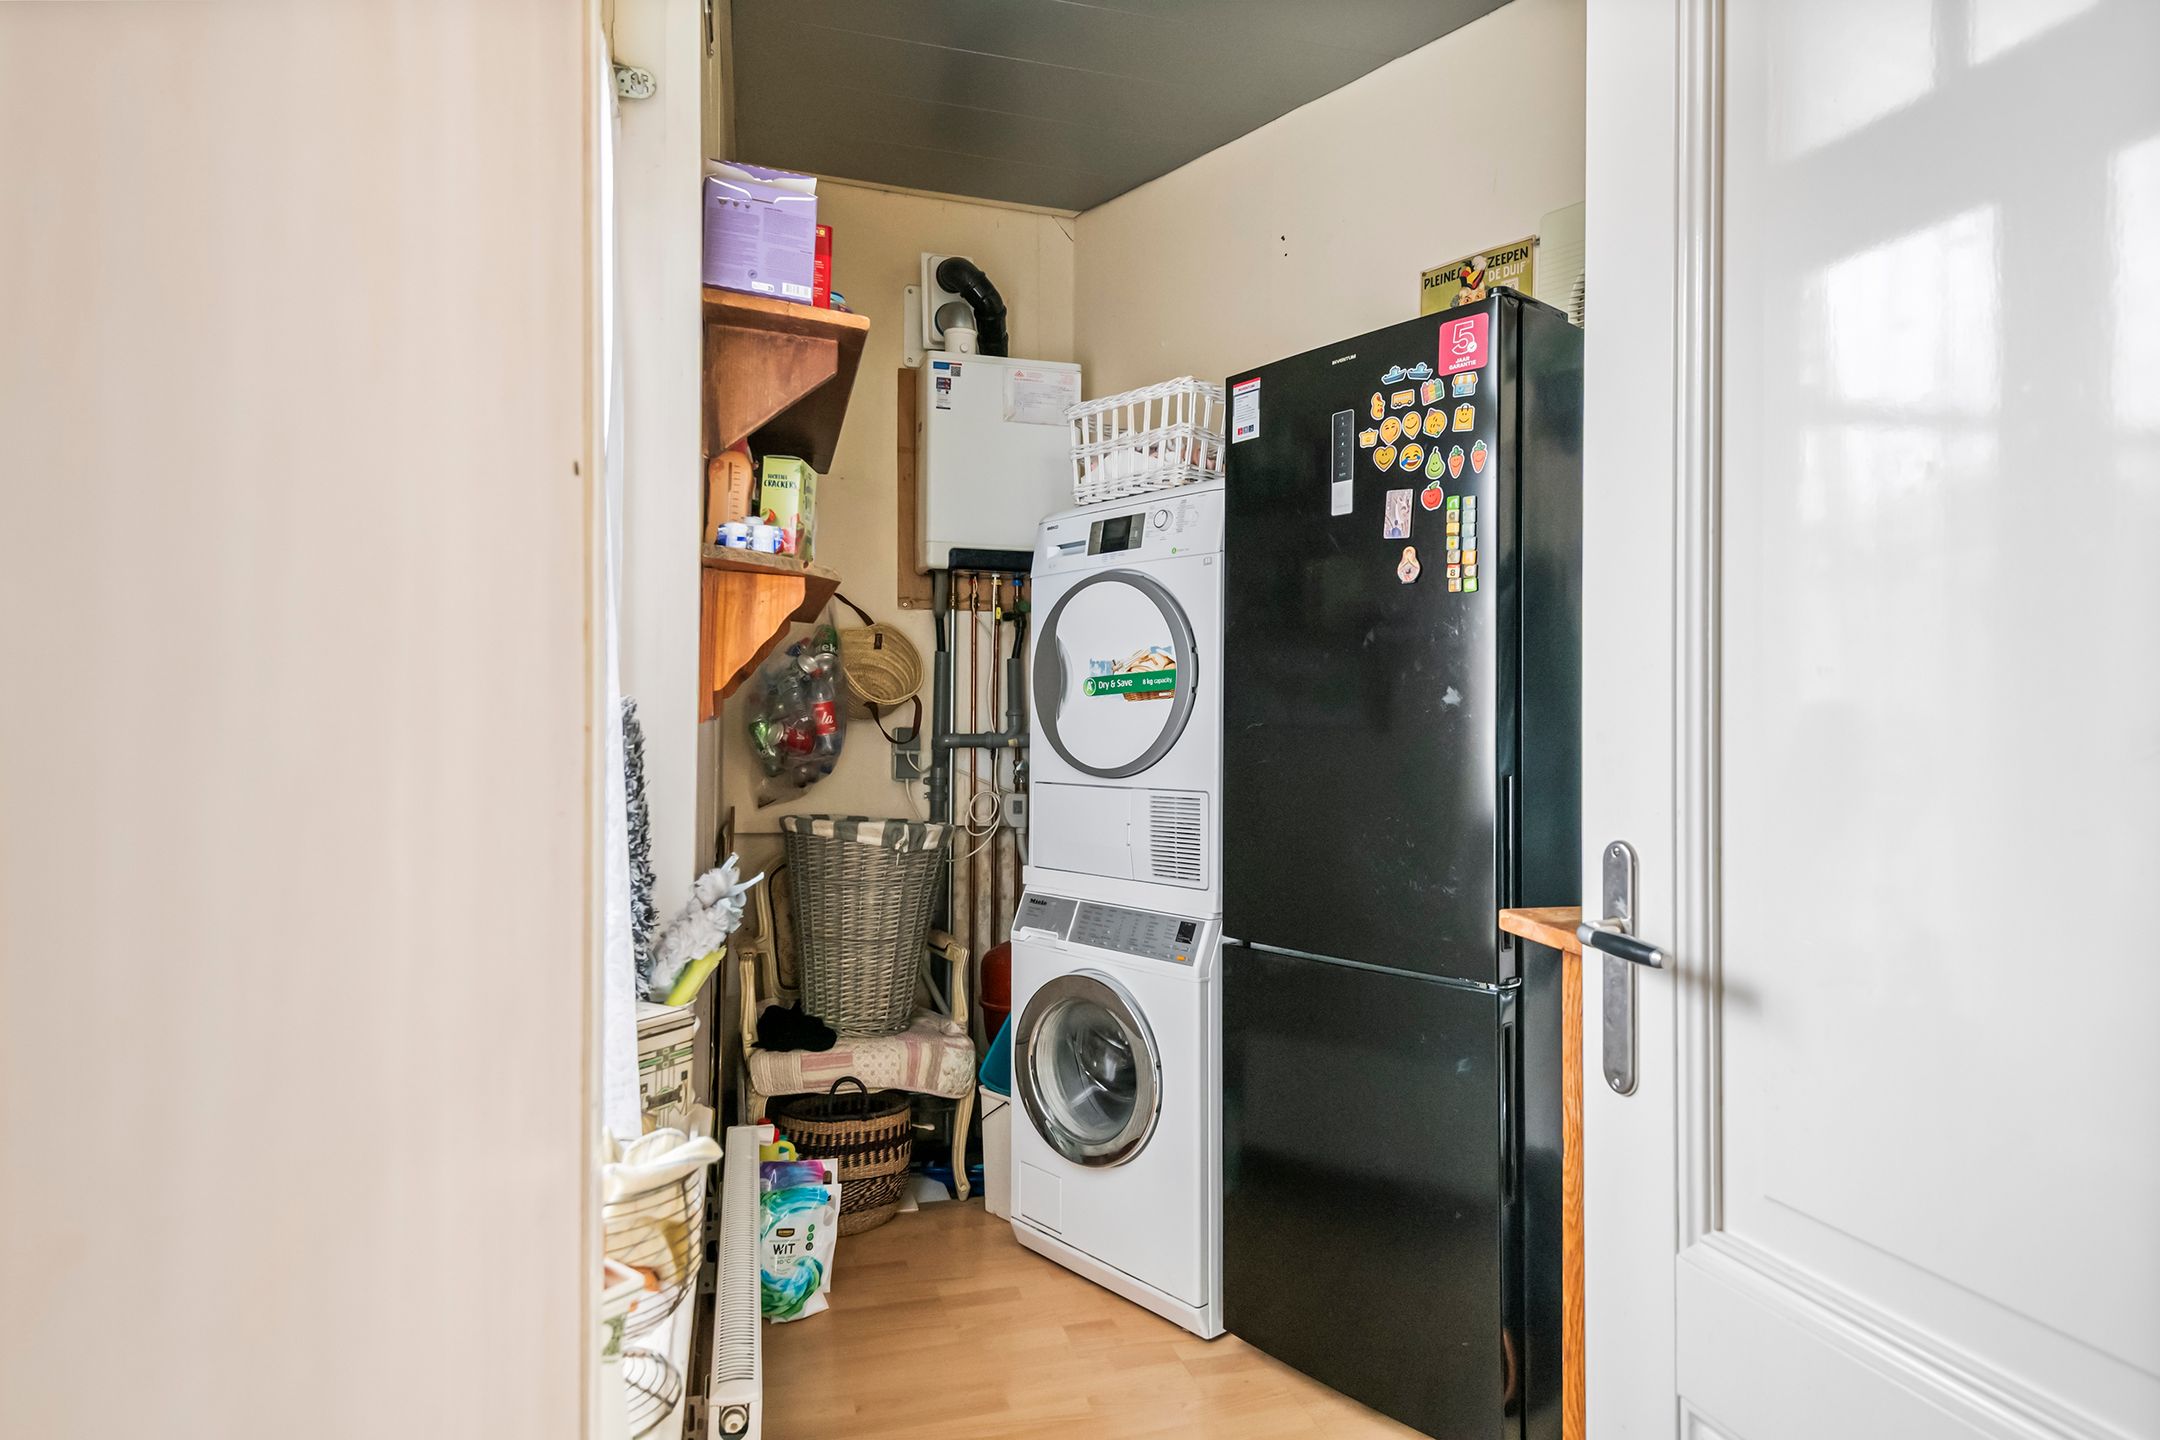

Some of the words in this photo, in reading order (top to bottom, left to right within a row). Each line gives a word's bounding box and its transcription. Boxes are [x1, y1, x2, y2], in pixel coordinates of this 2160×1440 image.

[1487, 247, 1528, 268] ZEEPEN
[1488, 268, 1501, 282] DE
[1503, 261, 1526, 277] DUIF
[1451, 320, 1475, 355] 5
[1449, 360, 1477, 370] GARANTIE
[1455, 356, 1470, 364] JAAR
[1098, 681, 1110, 690] Dry
[1110, 679, 1116, 688] &
[1116, 679, 1133, 687] Save
[1146, 677, 1154, 686] kg
[1153, 677, 1172, 685] capacity
[1030, 898, 1047, 906] Miele
[773, 1243, 795, 1255] WIT
